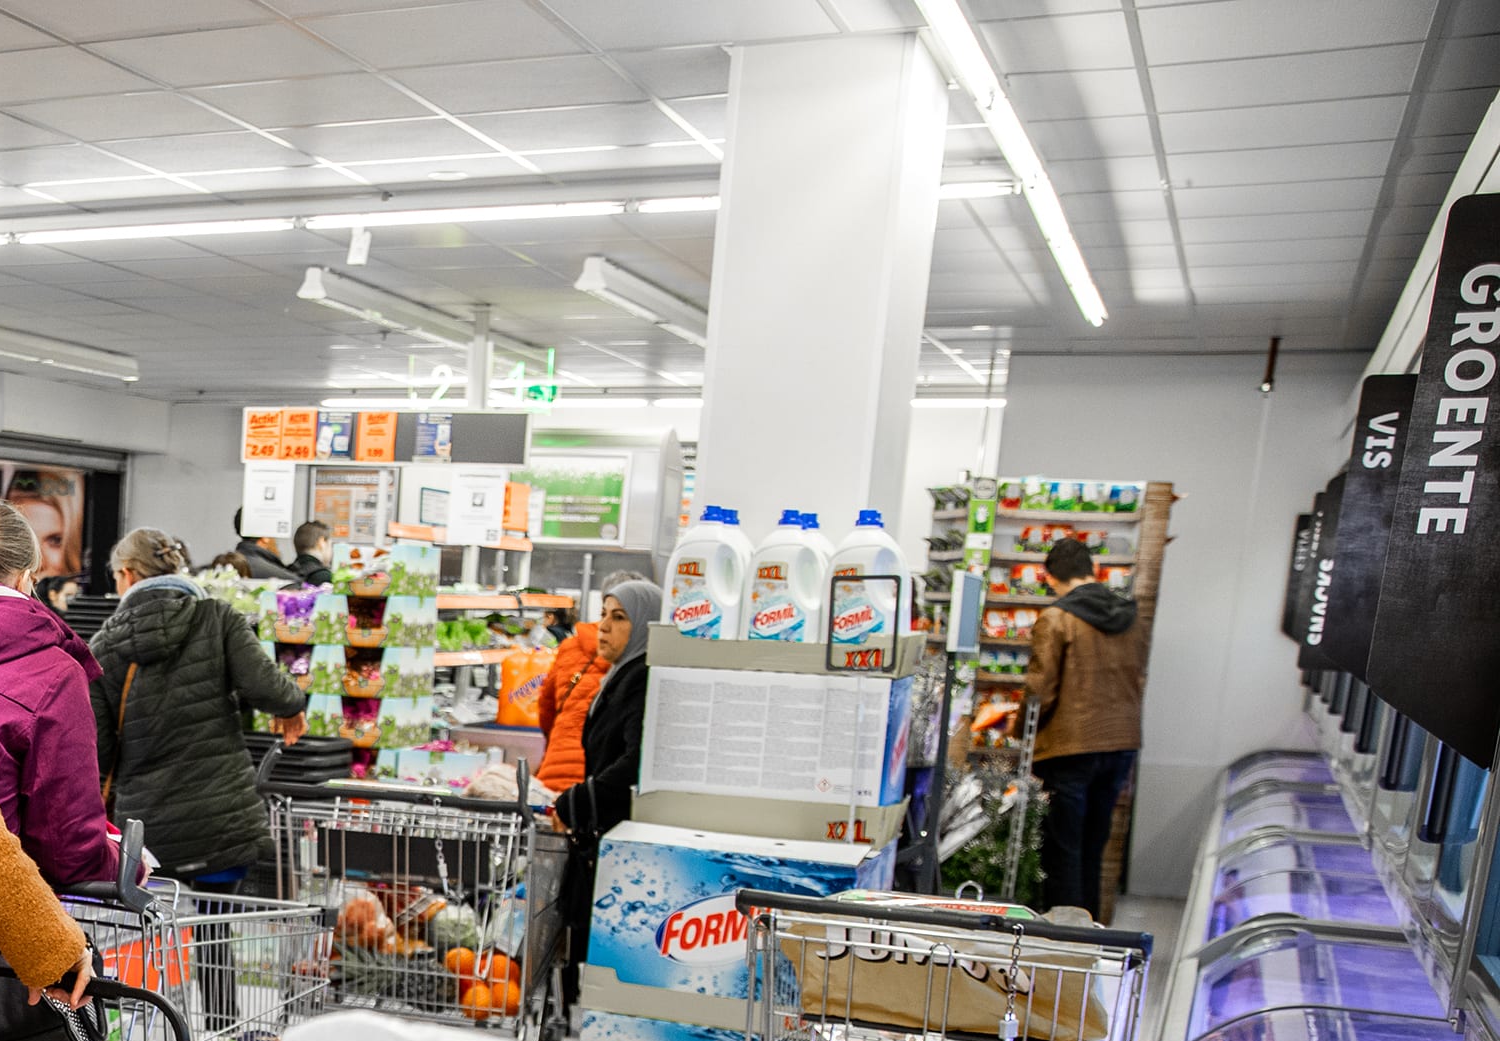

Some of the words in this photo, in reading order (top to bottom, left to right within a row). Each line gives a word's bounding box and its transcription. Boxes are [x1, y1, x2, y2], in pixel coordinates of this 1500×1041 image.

[1417, 263, 1500, 534] GROENTE
[1362, 411, 1399, 469] VIS
[677, 561, 705, 576] XXL
[757, 565, 785, 580] XXL
[672, 599, 713, 624] FORMIL
[1306, 558, 1335, 646] SNACKS
[753, 603, 796, 629] FORMIL
[833, 605, 875, 631] FORMIL
